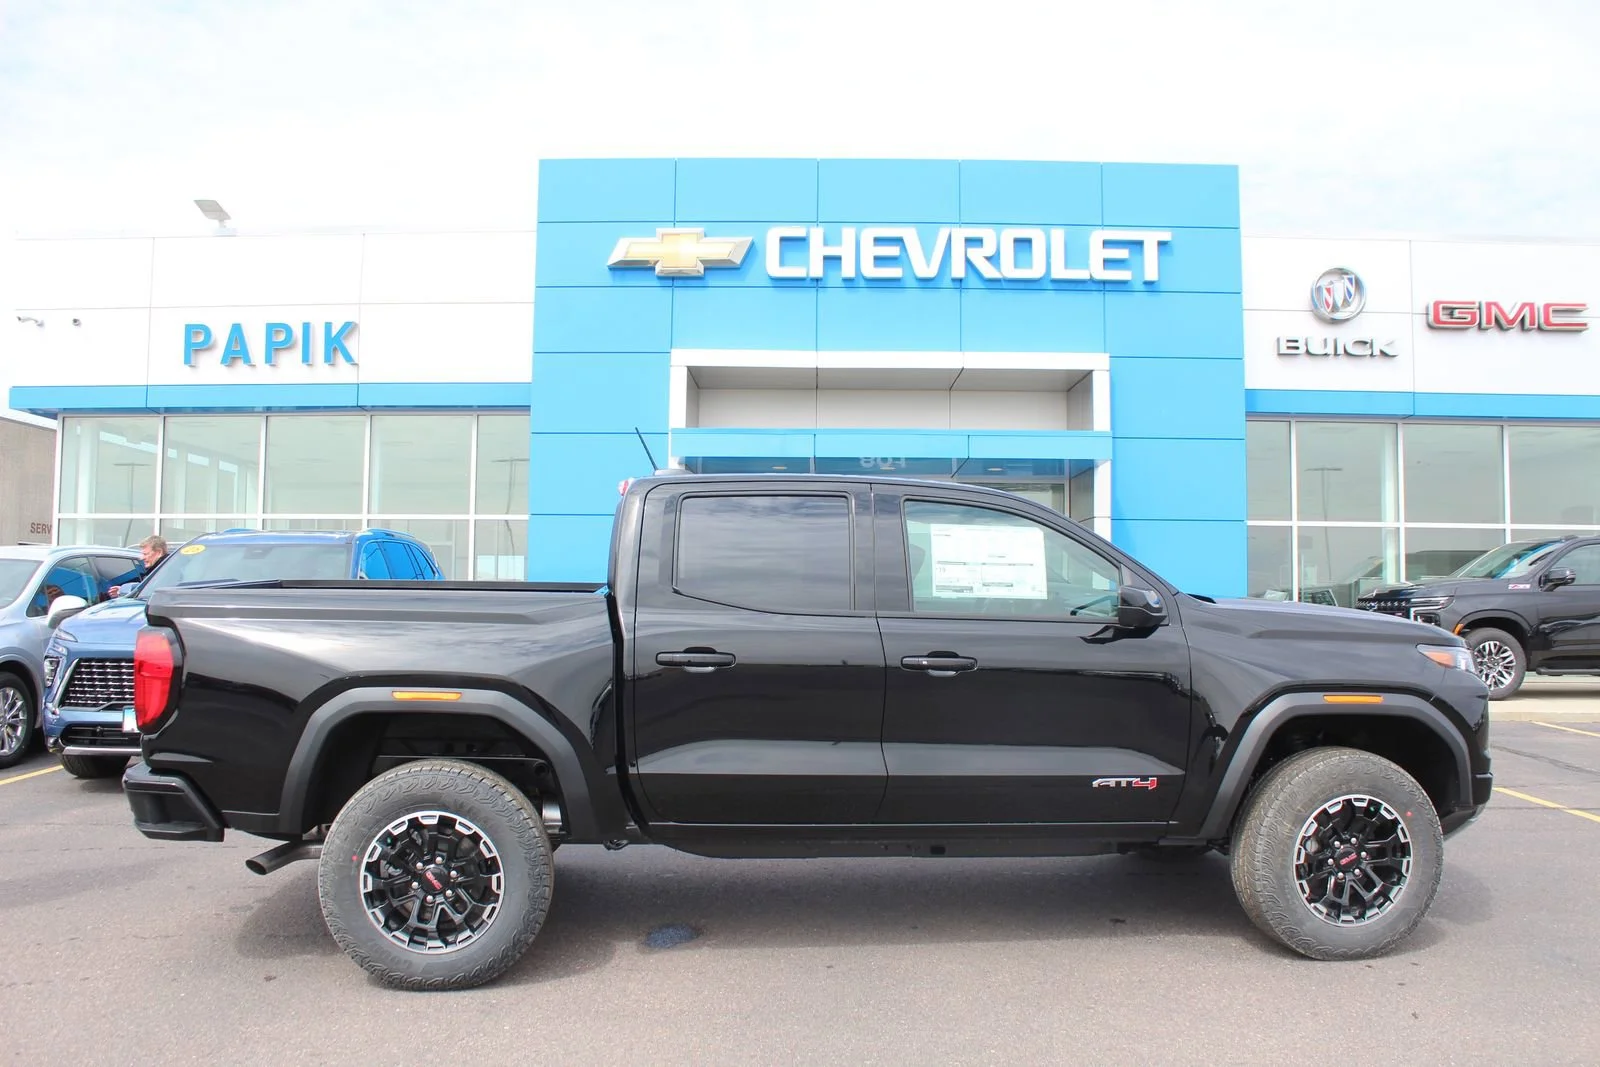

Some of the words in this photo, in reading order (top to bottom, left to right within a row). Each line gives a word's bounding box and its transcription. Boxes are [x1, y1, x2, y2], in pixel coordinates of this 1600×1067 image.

[765, 226, 1172, 283] CHEVROLET
[1426, 300, 1590, 332] GMC
[184, 321, 358, 368] PAPIK
[1277, 336, 1398, 358] BUICK
[1092, 777, 1158, 791] AT4
